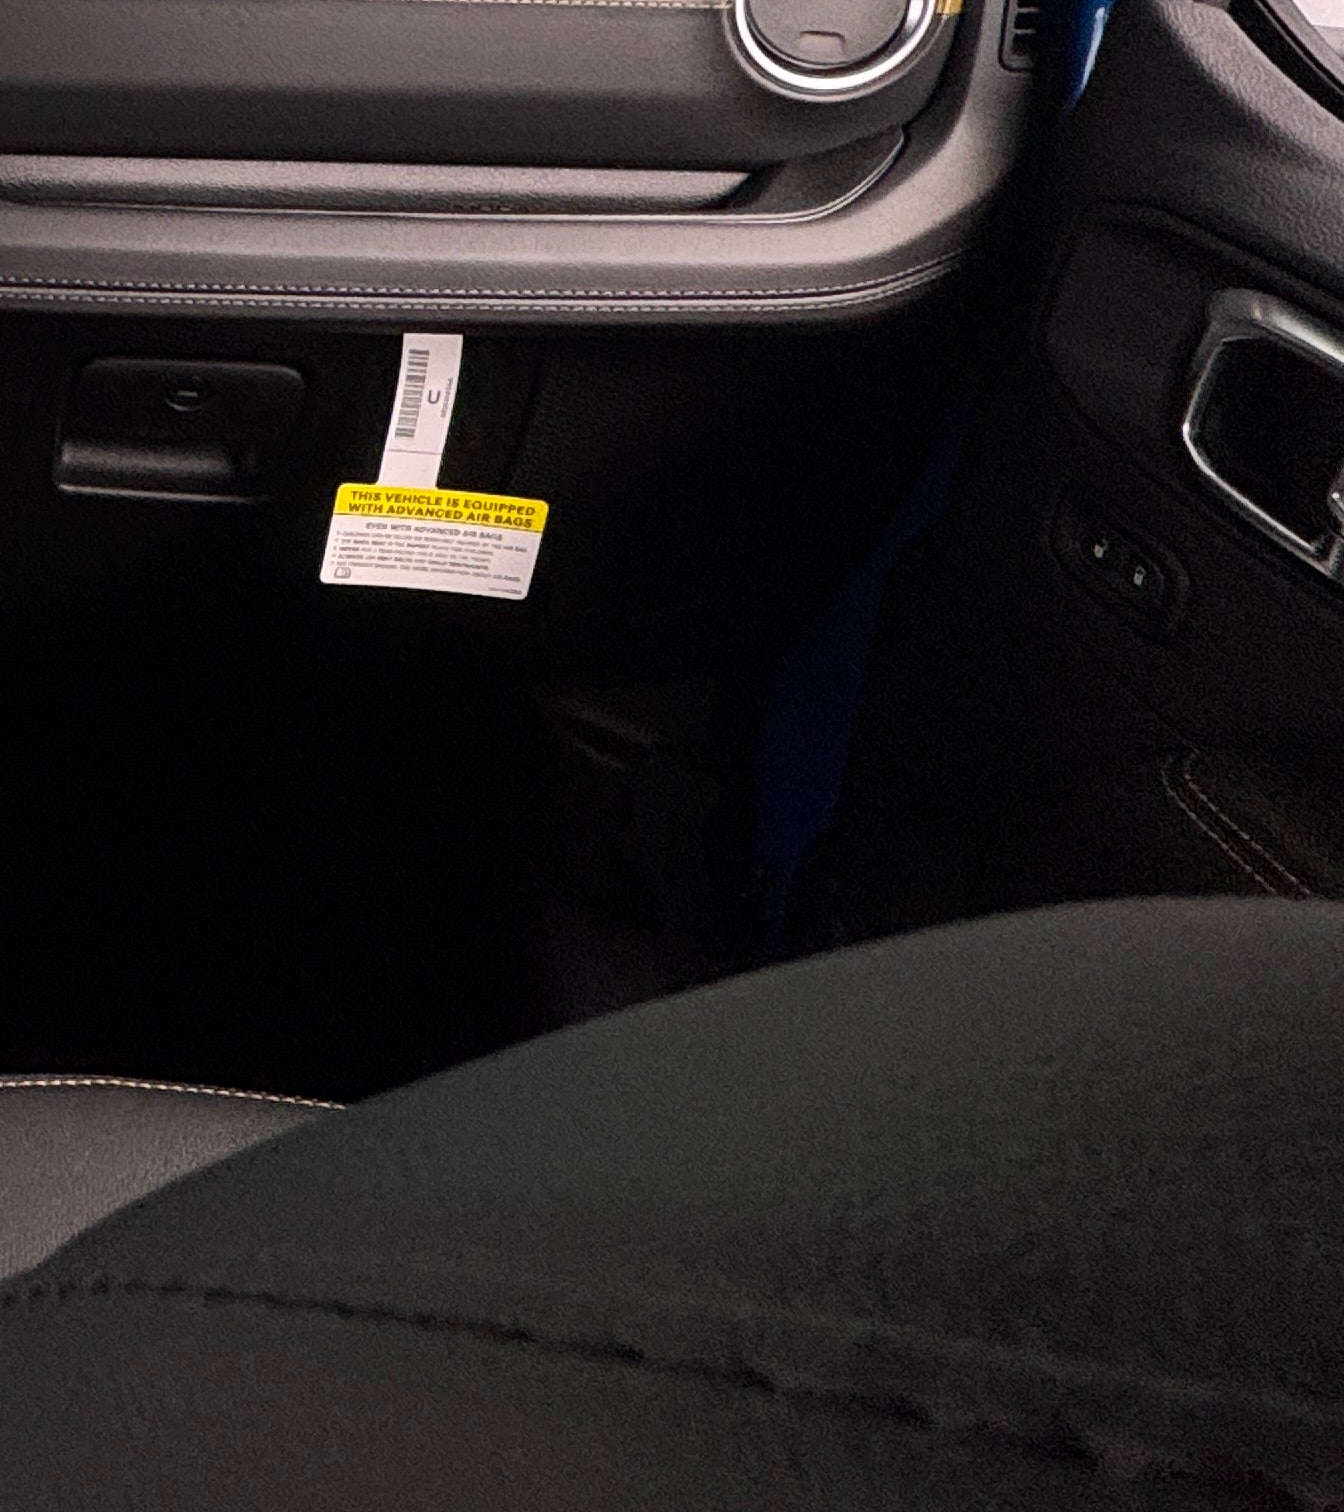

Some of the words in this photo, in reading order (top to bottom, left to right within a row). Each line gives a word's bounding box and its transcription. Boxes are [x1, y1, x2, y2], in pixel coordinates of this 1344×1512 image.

[348, 502, 383, 514] WITH
[386, 505, 463, 519] ADVANCED
[466, 511, 490, 523] AIR
[494, 514, 533, 528] BAGS
[350, 490, 381, 501] THIS
[385, 492, 444, 506] VEHICLE
[446, 497, 460, 509] IS
[463, 499, 537, 516] EQUIPPED
